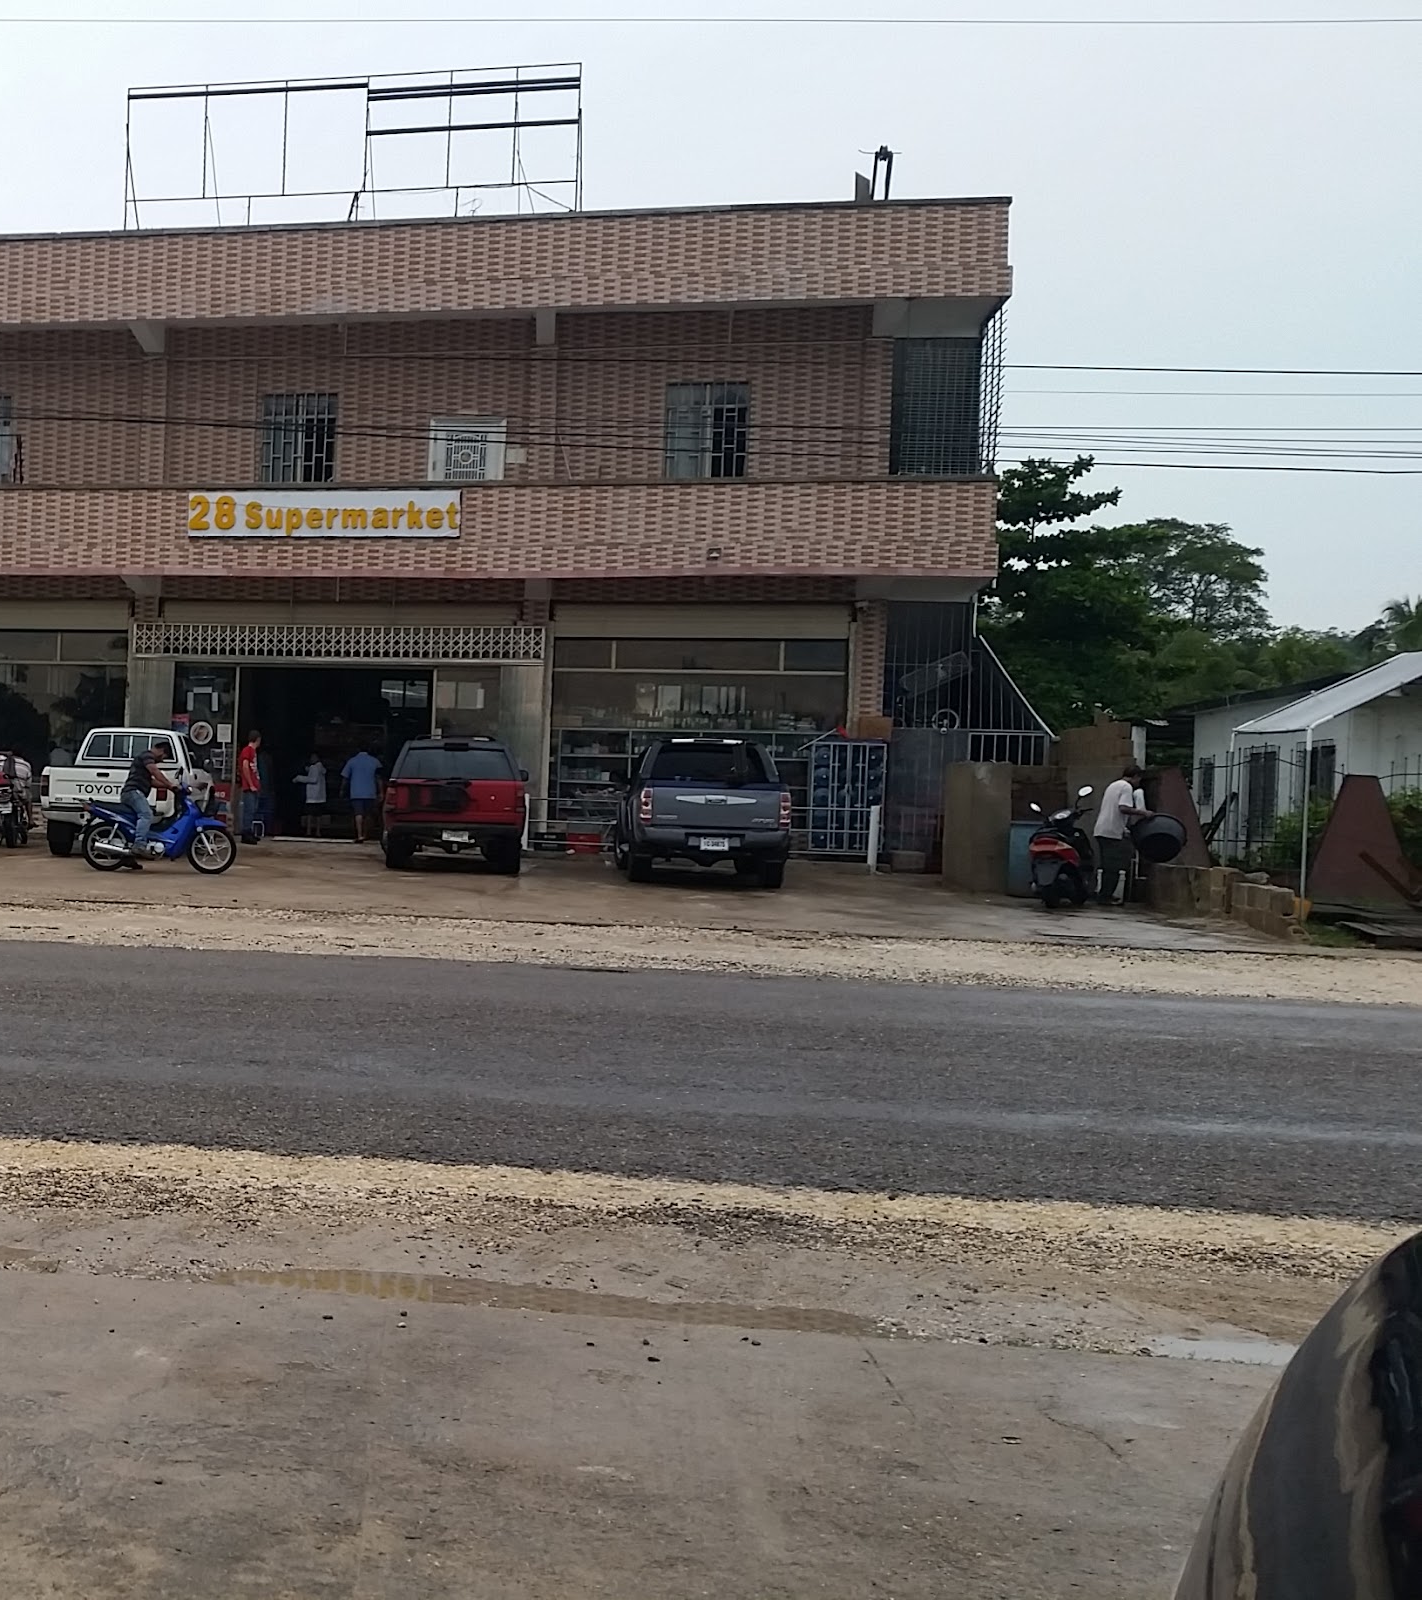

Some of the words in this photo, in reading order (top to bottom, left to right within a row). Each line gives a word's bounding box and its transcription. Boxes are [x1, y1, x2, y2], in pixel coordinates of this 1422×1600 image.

[188, 495, 237, 531] 28
[245, 501, 460, 537] Supermarket
[76, 784, 122, 795] TOYOT
